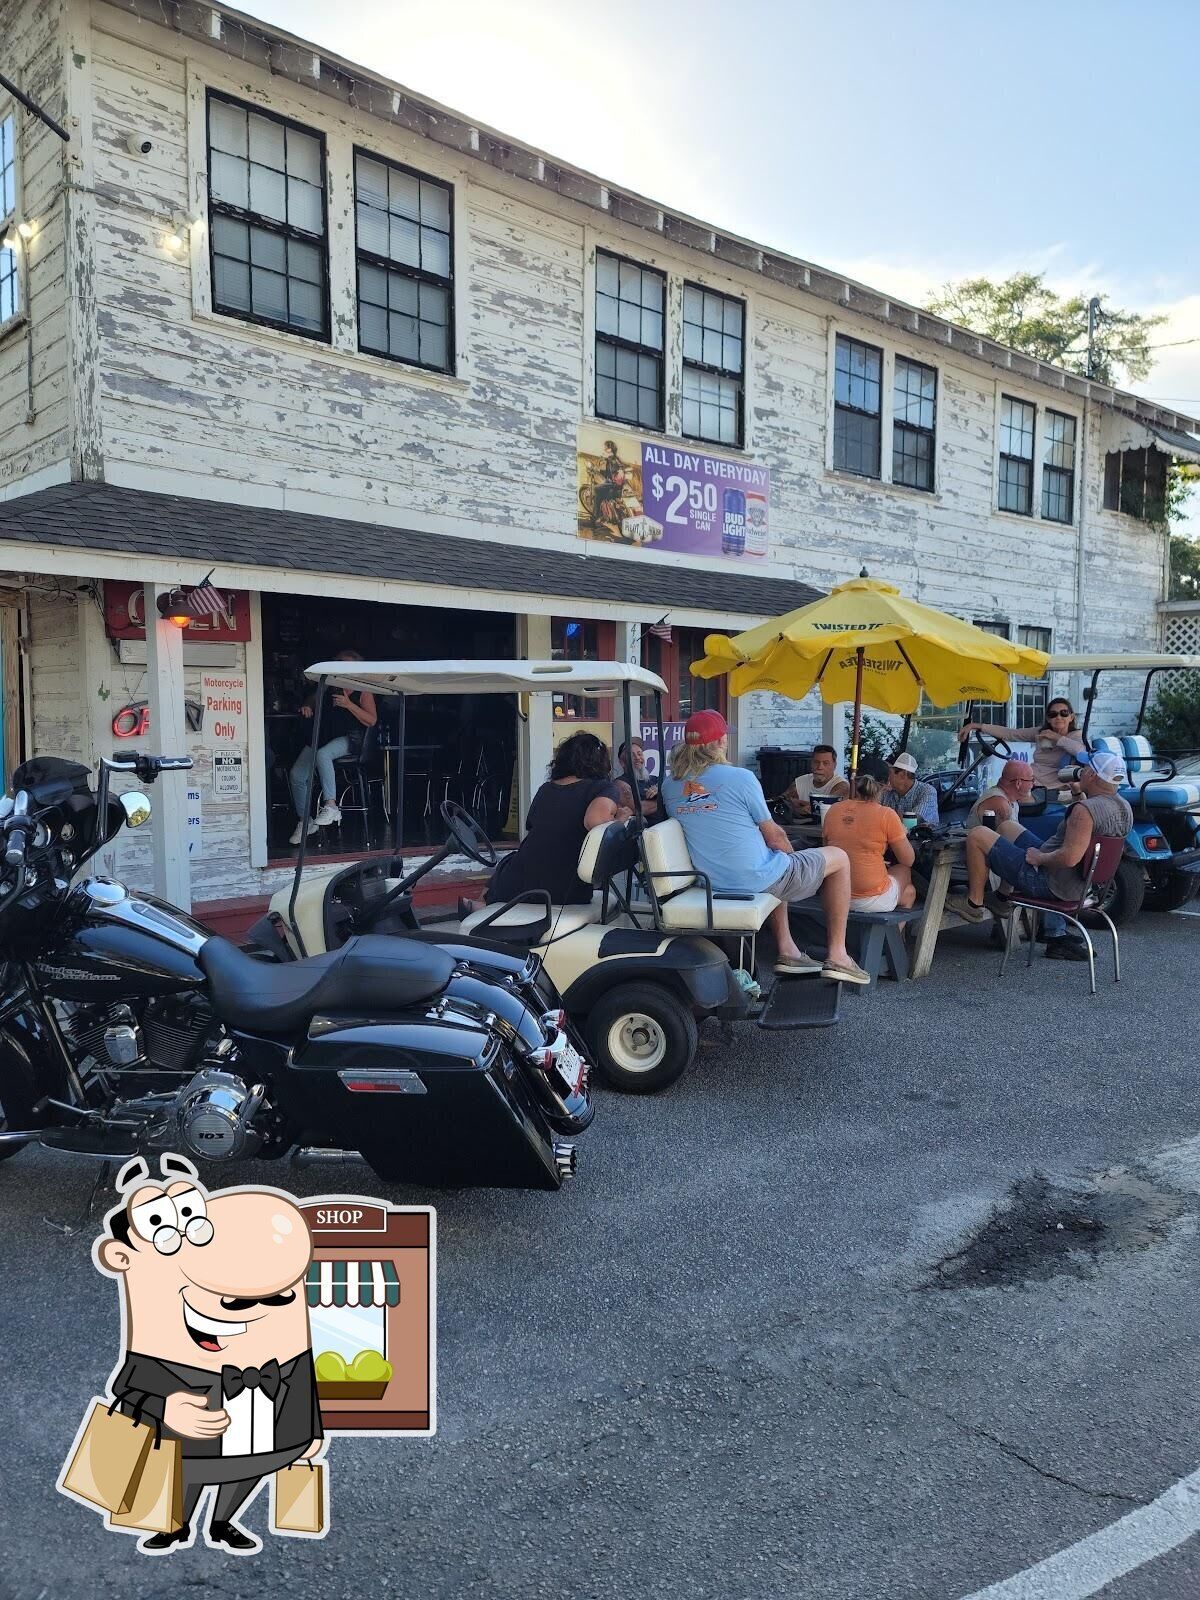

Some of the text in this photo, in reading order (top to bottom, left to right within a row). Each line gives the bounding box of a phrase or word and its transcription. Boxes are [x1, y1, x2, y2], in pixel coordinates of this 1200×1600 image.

[644, 446, 767, 486] ALL DAY EVERYDAY
[690, 510, 717, 522] SINGLE
[725, 512, 744, 526] BUD
[695, 521, 711, 532] CAN
[722, 523, 745, 537] LIGHT
[811, 623, 867, 631] TWISTED
[204, 677, 244, 690] Motorcycle
[207, 696, 242, 714] Parking
[214, 722, 236, 739] Only
[221, 757, 235, 765] NO
[199, 1132, 225, 1140] 103
